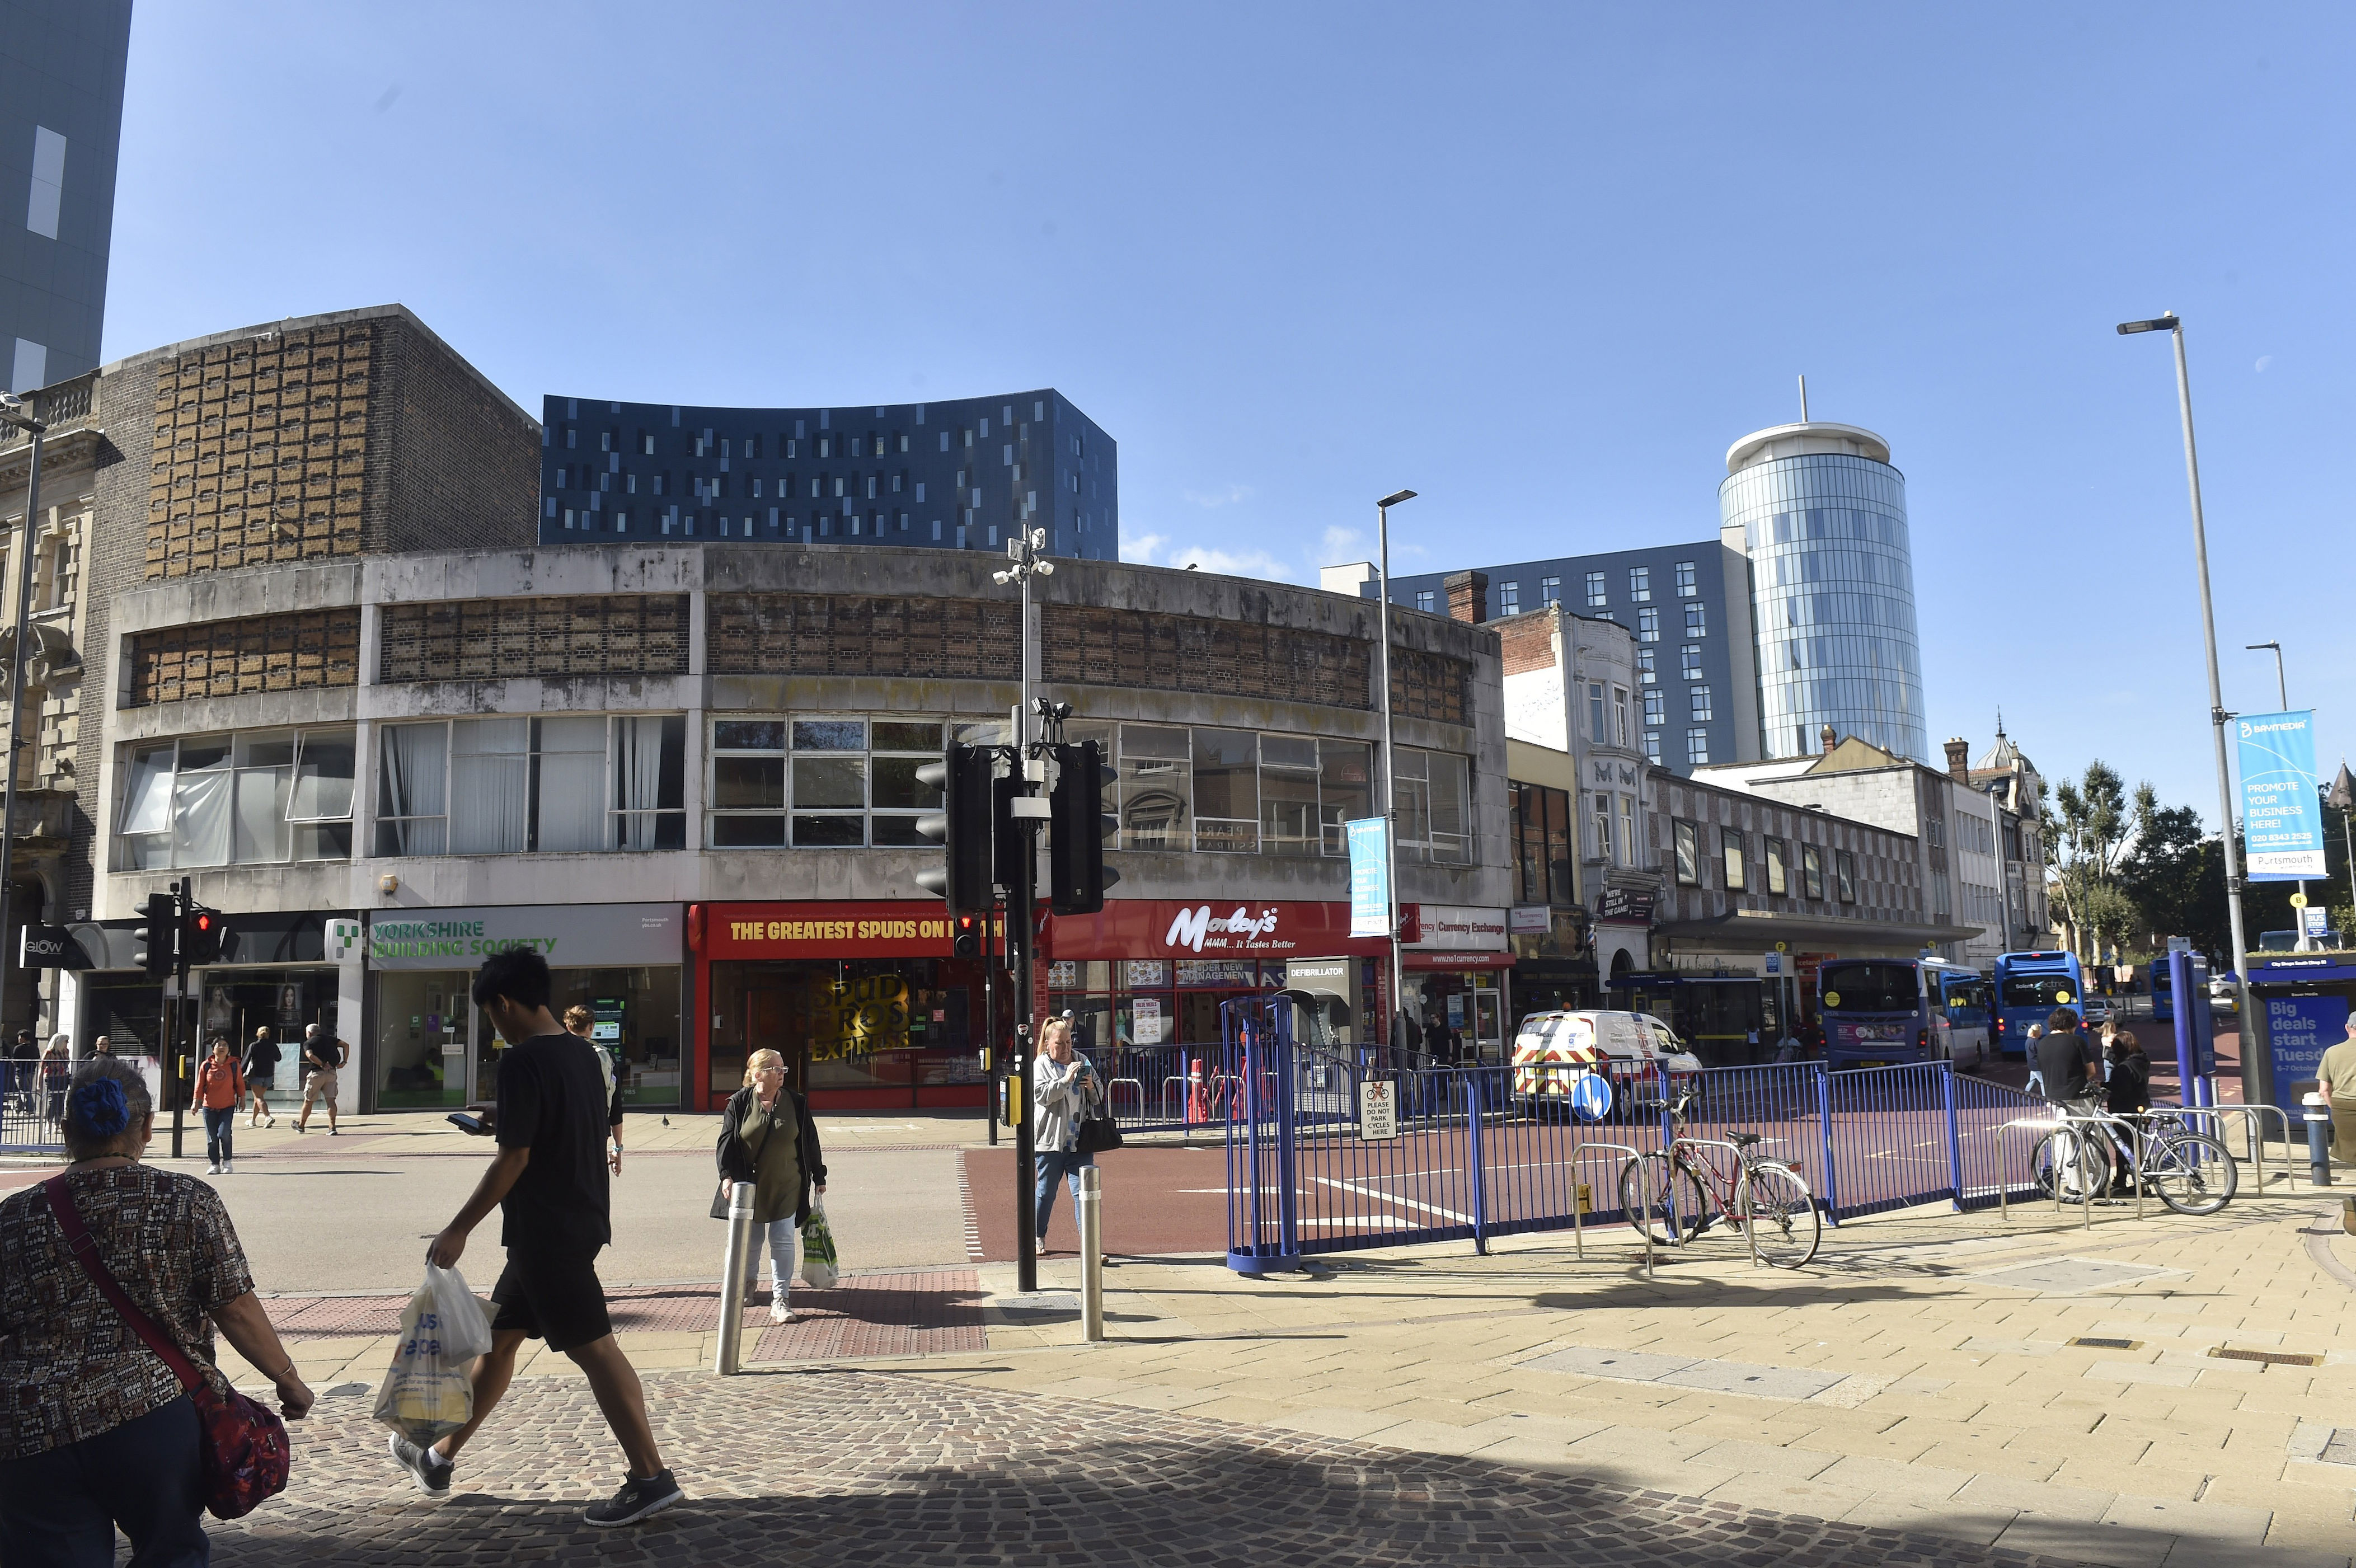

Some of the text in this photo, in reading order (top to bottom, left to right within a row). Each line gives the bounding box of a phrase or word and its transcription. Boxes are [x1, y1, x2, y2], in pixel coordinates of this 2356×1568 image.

[2254, 721, 2305, 733] BAYMEDIA
[2247, 781, 2298, 793] PROMOTE
[2249, 795, 2277, 805] YOUR
[2250, 806, 2302, 817] BUSINESS
[2250, 819, 2282, 829] HERE!
[1354, 868, 1378, 876] PROMOTE
[1606, 889, 1621, 898] WE'RE
[1605, 899, 1617, 908] STILL
[1604, 908, 1613, 917] THE
[1614, 904, 1628, 914] GAME!
[374, 921, 484, 940] YORKSHIRE
[731, 920, 1002, 940] THE GREATEST SPUDS ON ETH
[1165, 905, 1278, 952] Morley's
[1438, 921, 1471, 935] Currency
[1472, 922, 1505, 935] Exchange
[26, 940, 63, 954] GLOW
[374, 940, 464, 958] BUILDING
[1236, 940, 1243, 949] It
[1245, 939, 1270, 949] Tastes
[1271, 940, 1297, 949] Better
[1433, 954, 1489, 964] www.no1currency.com
[1226, 963, 1243, 971] NEW
[1291, 968, 1344, 977] DEFIBRILLATOR
[1183, 971, 1249, 980] MANAGEMENT
[2270, 1002, 2297, 1017] Big
[815, 1001, 903, 1034] ROS
[2272, 1017, 2317, 1030] deals
[2274, 1032, 2317, 1046] start
[812, 1031, 909, 1062] EXPRESS
[2275, 1047, 2323, 1062] Tuesd
